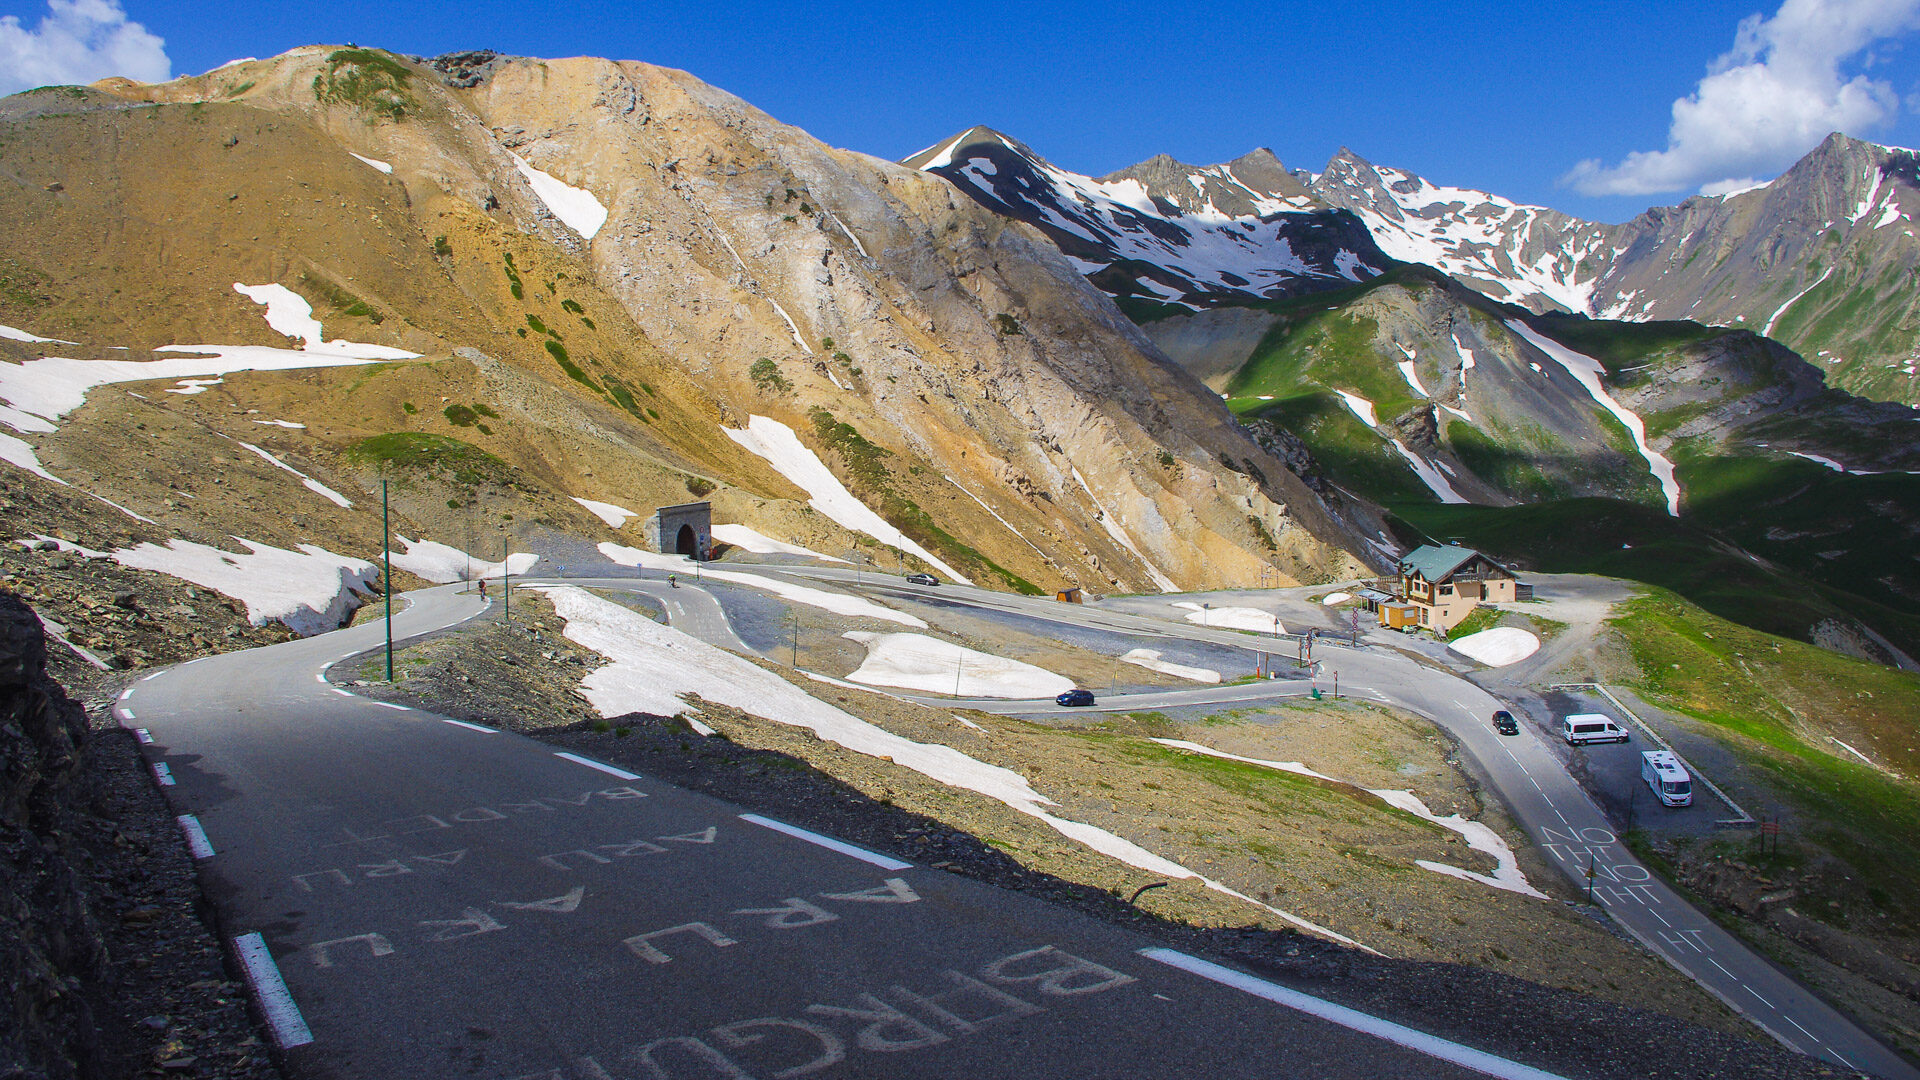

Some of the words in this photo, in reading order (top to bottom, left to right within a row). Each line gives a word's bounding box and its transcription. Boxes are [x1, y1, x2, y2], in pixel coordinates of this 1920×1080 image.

[291, 848, 468, 892] ARU
[538, 826, 718, 870] ARU
[308, 885, 586, 968] ARU
[622, 877, 922, 966] ARU
[508, 945, 1140, 1080] BARGU
